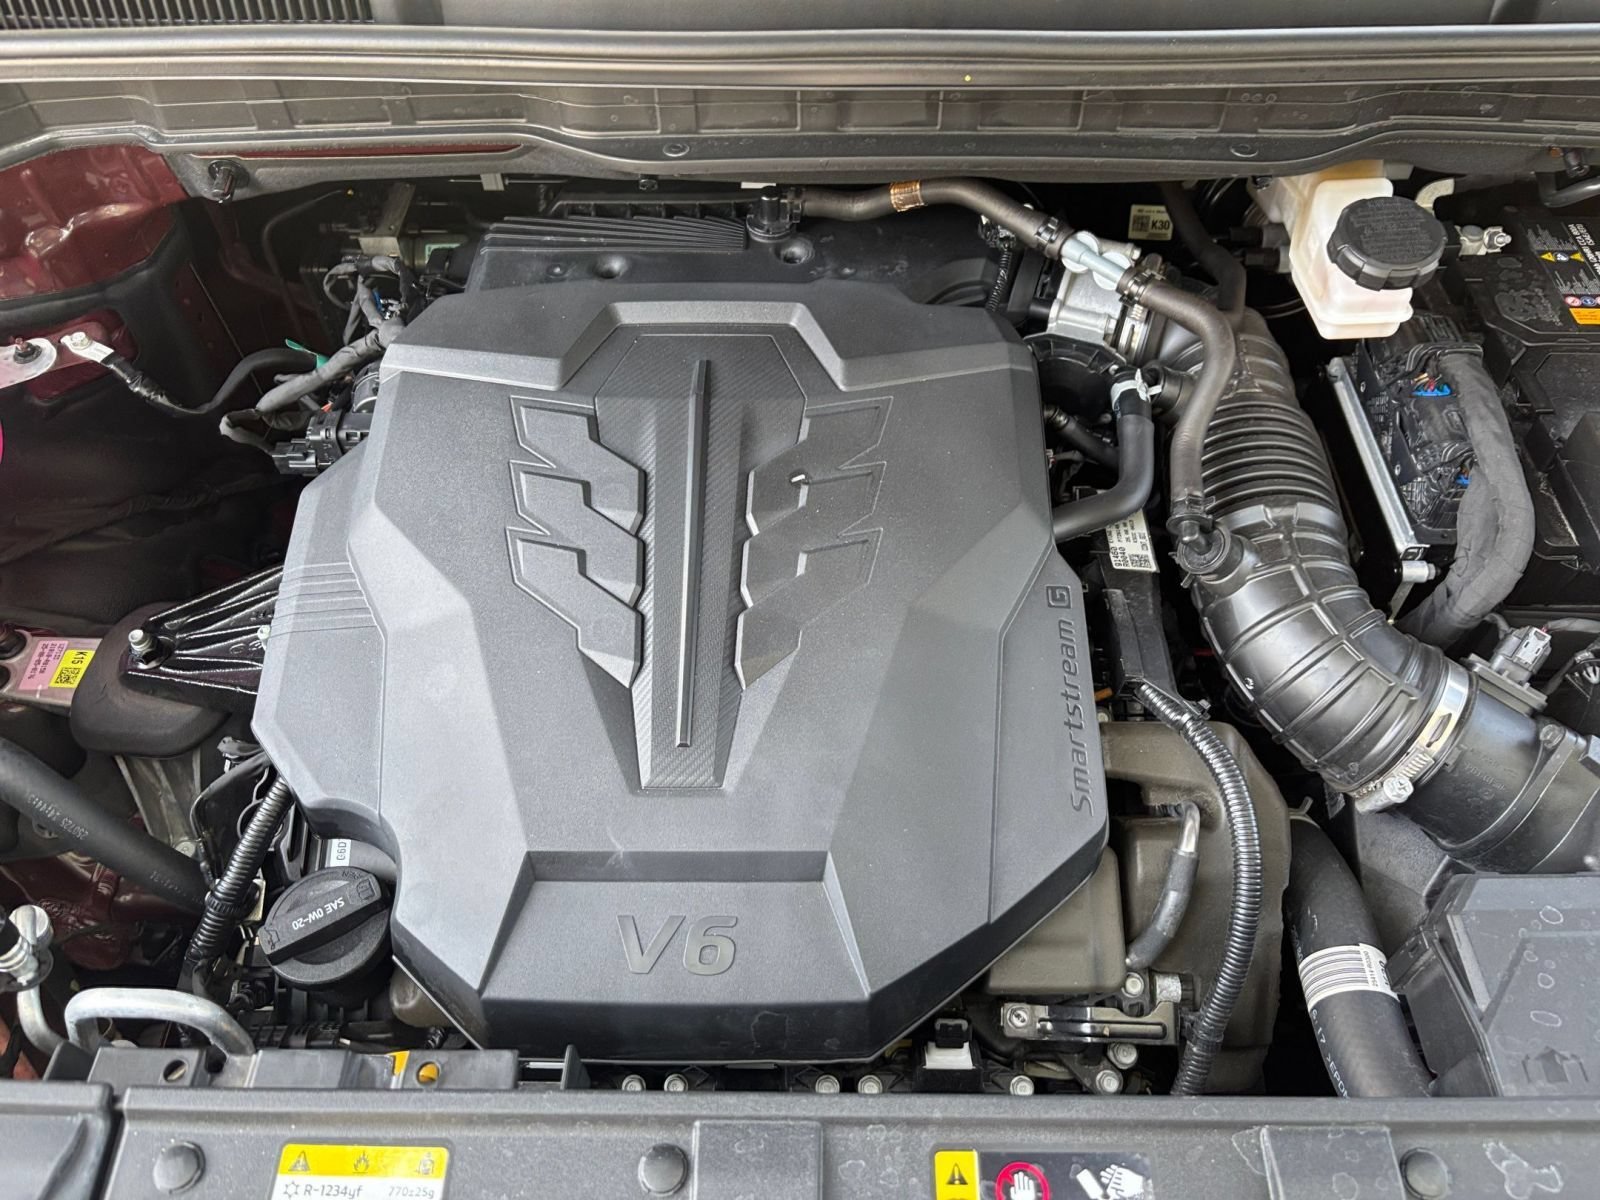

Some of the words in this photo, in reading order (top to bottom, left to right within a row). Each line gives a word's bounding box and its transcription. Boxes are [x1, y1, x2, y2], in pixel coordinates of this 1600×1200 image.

[71, 651, 89, 665] K15
[1058, 618, 1094, 817] Smartstream
[323, 896, 345, 915] SAE
[291, 908, 324, 931] 0W-20
[616, 914, 739, 977] V6
[303, 1183, 363, 1199] R-1234yf
